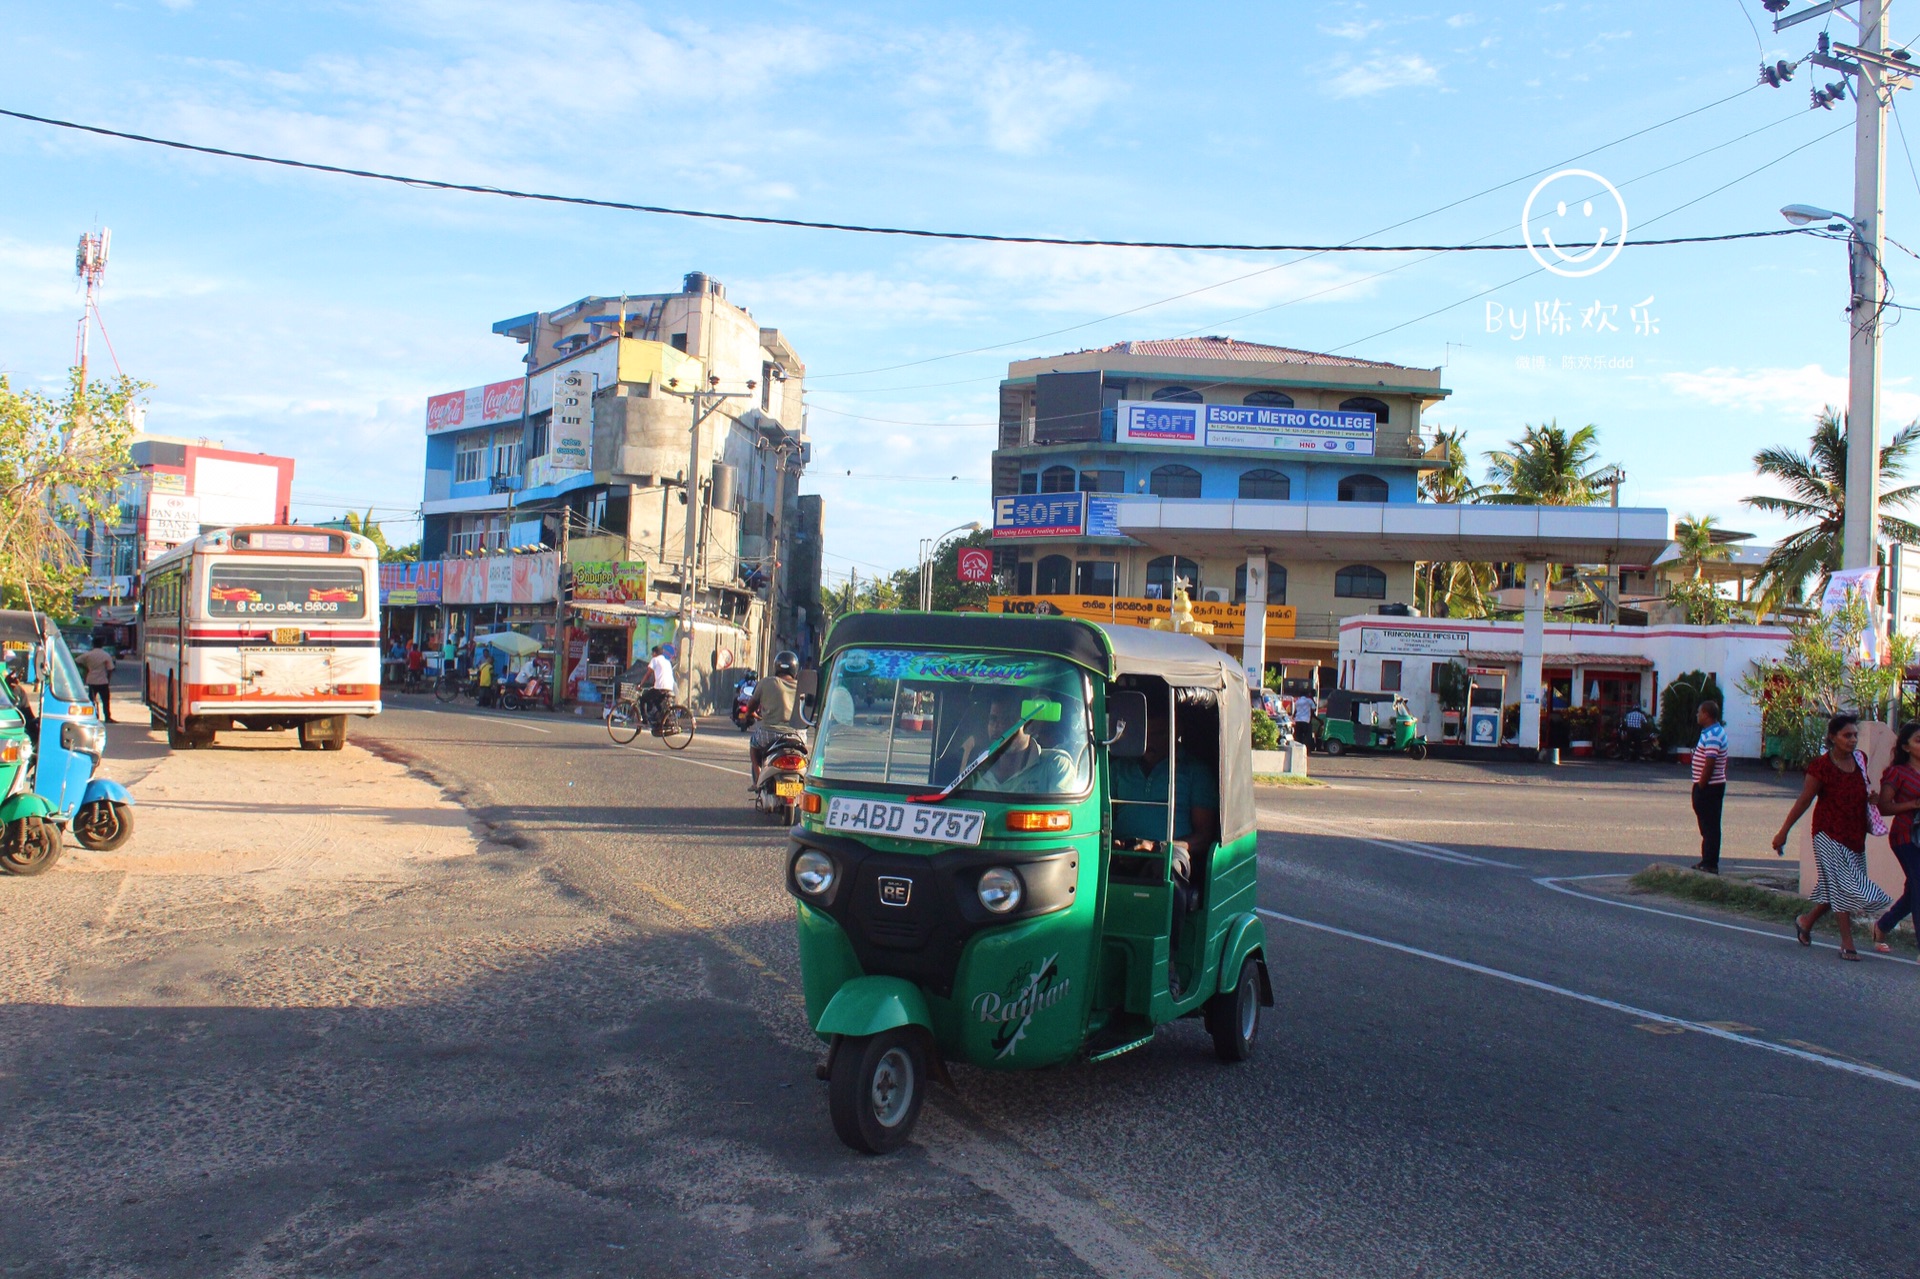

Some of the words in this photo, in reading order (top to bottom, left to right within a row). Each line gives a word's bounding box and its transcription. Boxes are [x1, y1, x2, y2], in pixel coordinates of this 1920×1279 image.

[151, 508, 171, 518] PAN
[174, 511, 197, 521] ASIA
[158, 520, 189, 531] BANK
[162, 529, 186, 539] ATM
[996, 529, 1017, 537] Shaping
[1033, 527, 1055, 536] Creating
[963, 569, 986, 579] AIA
[1212, 620, 1235, 629] Bank
[1383, 630, 1431, 639] TRINCOMALEE
[853, 803, 905, 832] ABD
[913, 809, 980, 840] 5757
[884, 886, 906, 900] RE
[971, 978, 1070, 1023] Raihan
